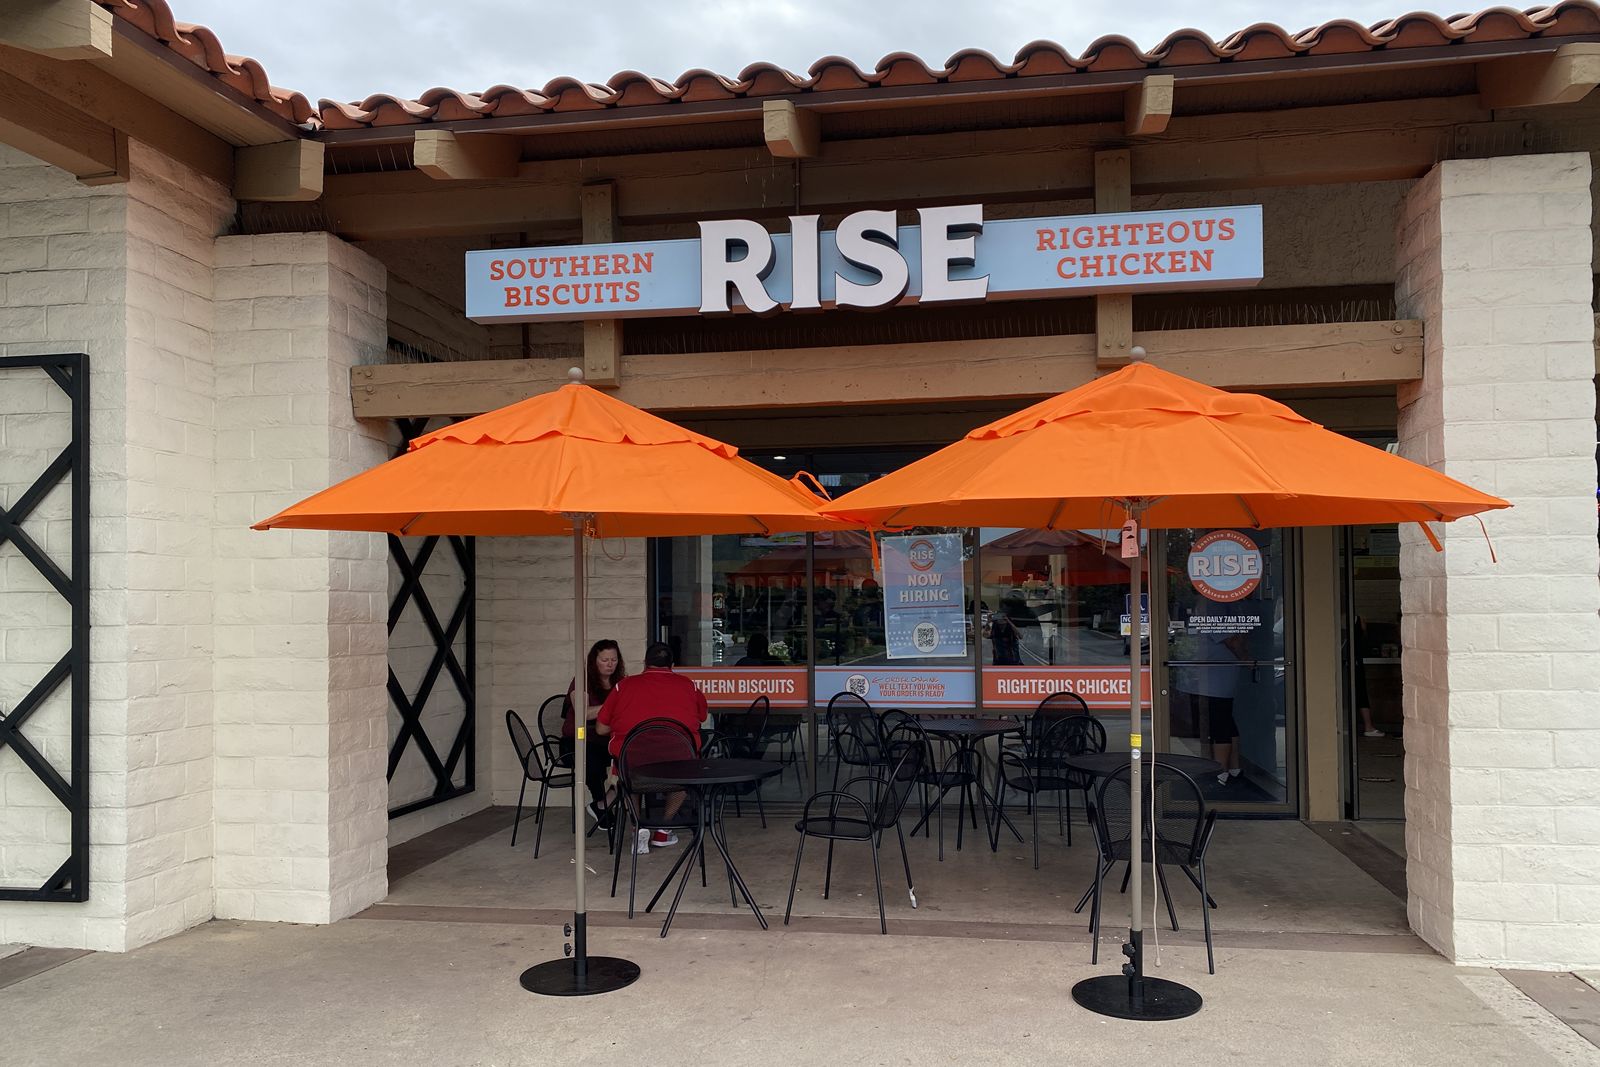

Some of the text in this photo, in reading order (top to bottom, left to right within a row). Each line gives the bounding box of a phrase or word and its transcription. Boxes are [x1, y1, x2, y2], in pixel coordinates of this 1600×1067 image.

[1036, 218, 1235, 251] RIGHTEOUS
[490, 252, 654, 281] SOUTHERN
[697, 204, 990, 314] RISE
[1056, 249, 1214, 279] CHICKEN
[504, 280, 641, 307] BISCUITS
[910, 550, 934, 560] RISE
[1192, 554, 1259, 577] RISE
[907, 574, 943, 587] NOW
[900, 589, 949, 603] HIRING
[692, 679, 795, 694] THERN BISCUITS
[997, 679, 1074, 694] RIGHTEOUS
